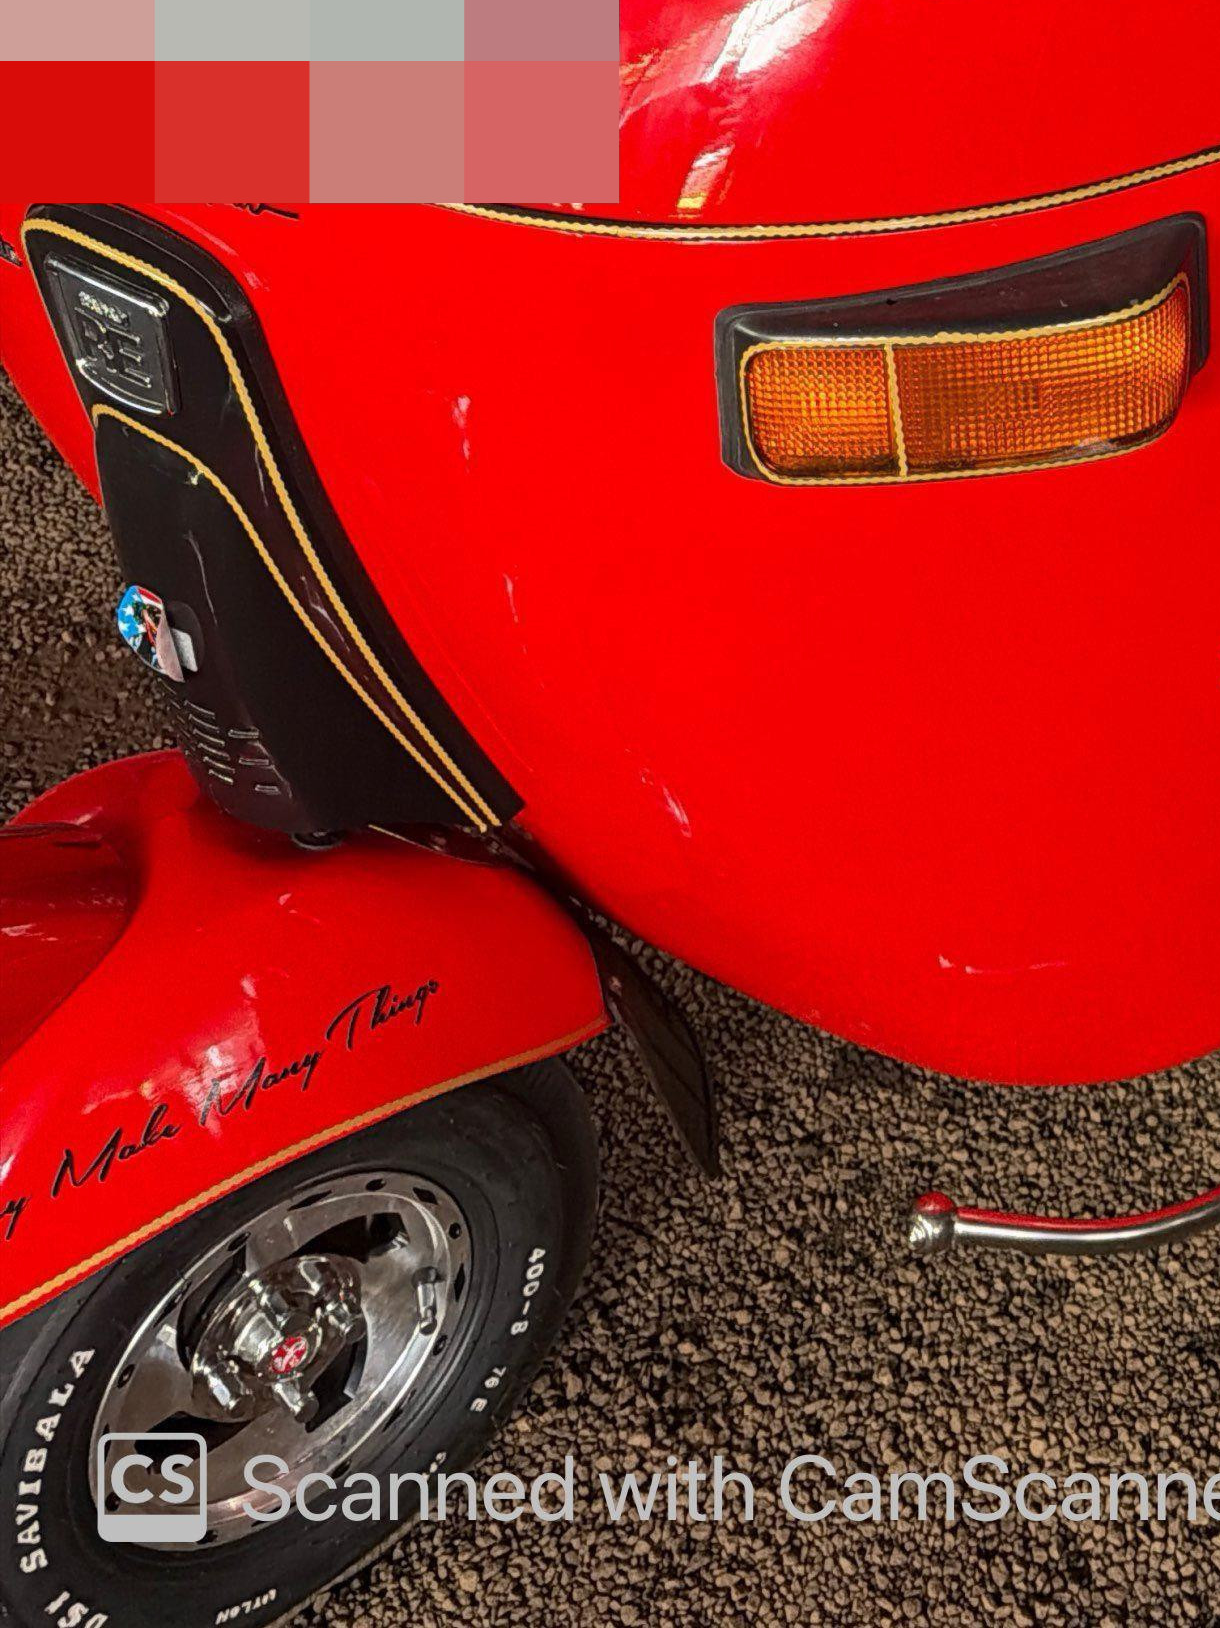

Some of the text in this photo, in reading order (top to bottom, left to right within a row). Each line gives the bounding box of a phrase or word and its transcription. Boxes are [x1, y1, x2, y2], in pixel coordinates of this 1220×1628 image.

[51, 979, 440, 1199] Make Many Things
[15, 1348, 96, 1574] SAVIBALA
